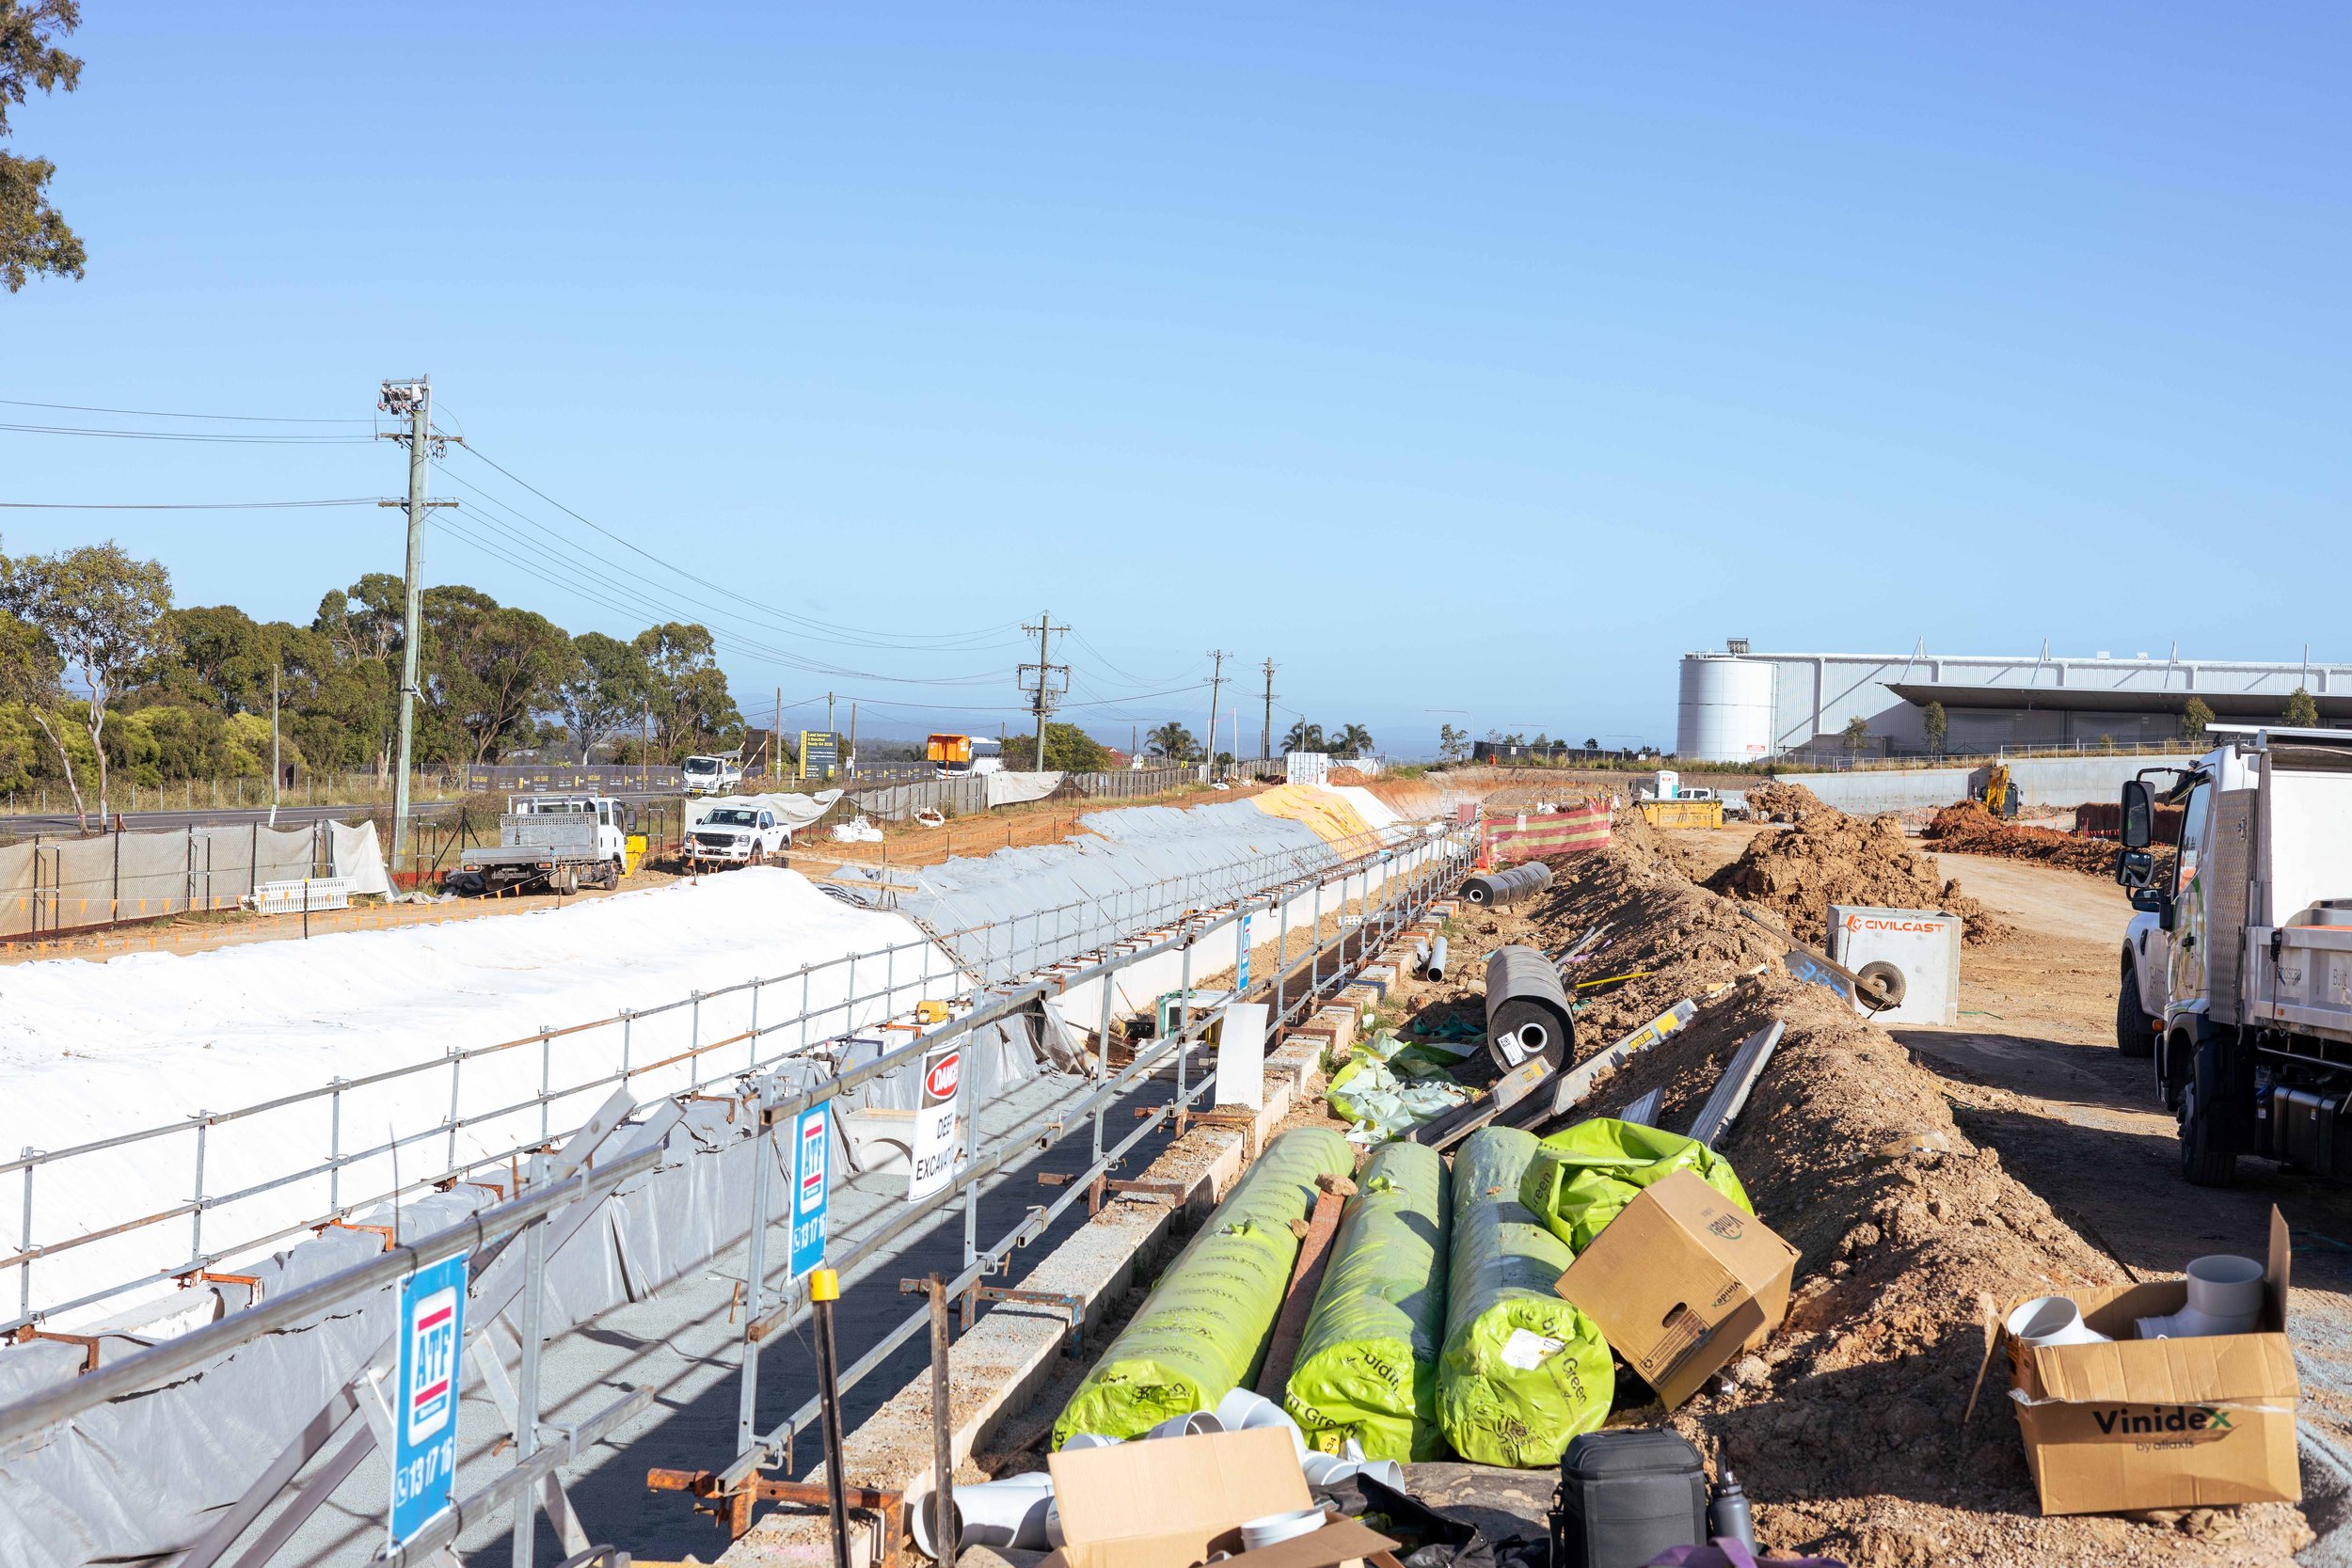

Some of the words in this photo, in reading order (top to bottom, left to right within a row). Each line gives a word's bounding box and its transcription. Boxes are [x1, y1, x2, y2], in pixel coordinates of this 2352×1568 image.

[1865, 920, 1945, 933] CIVILCAST
[804, 1135, 822, 1178] ATF
[1532, 1172, 1552, 1209] reen
[801, 1221, 809, 1249] 13
[809, 1216, 818, 1243] 17
[1706, 1212, 1744, 1238] Vinidex
[1711, 1281, 1741, 1308] Vinidex
[416, 1322, 452, 1390] ATF
[1563, 1357, 1587, 1407] Green
[2093, 1407, 2233, 1434] Vinidex
[1325, 1436, 1337, 1454] A34
[2136, 1441, 2152, 1452] by
[408, 1456, 423, 1499] 13
[424, 1449, 438, 1487] 17
[439, 1435, 453, 1476] 16
